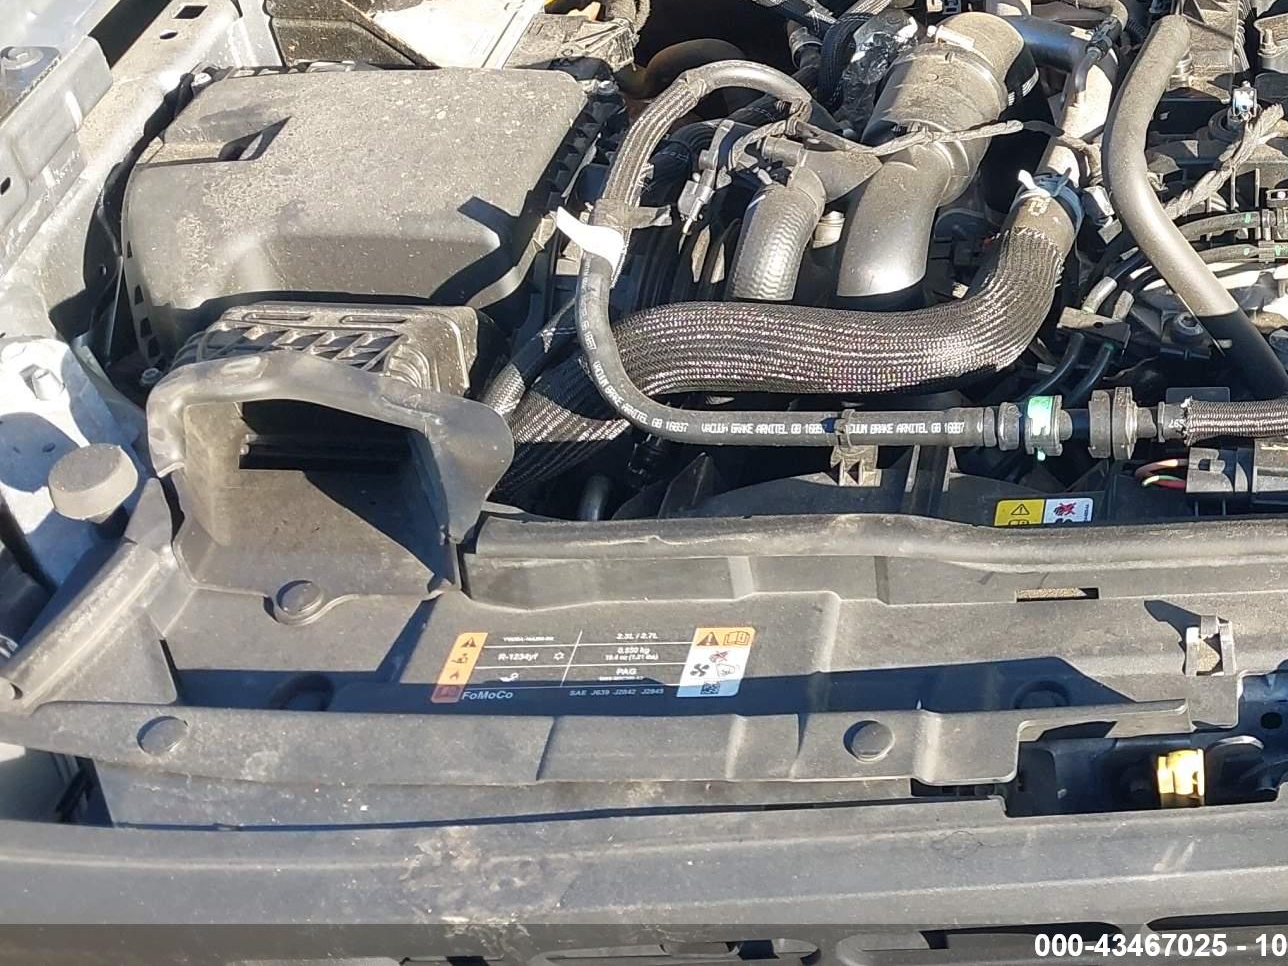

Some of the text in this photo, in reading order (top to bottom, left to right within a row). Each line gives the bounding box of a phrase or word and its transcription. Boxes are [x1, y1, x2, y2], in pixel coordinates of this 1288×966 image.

[870, 422, 894, 434] BRAKE
[895, 422, 929, 434] ARNITEL
[497, 652, 539, 662] R-1234yf
[616, 667, 637, 675] PAG
[461, 690, 514, 701] FoMoCo
